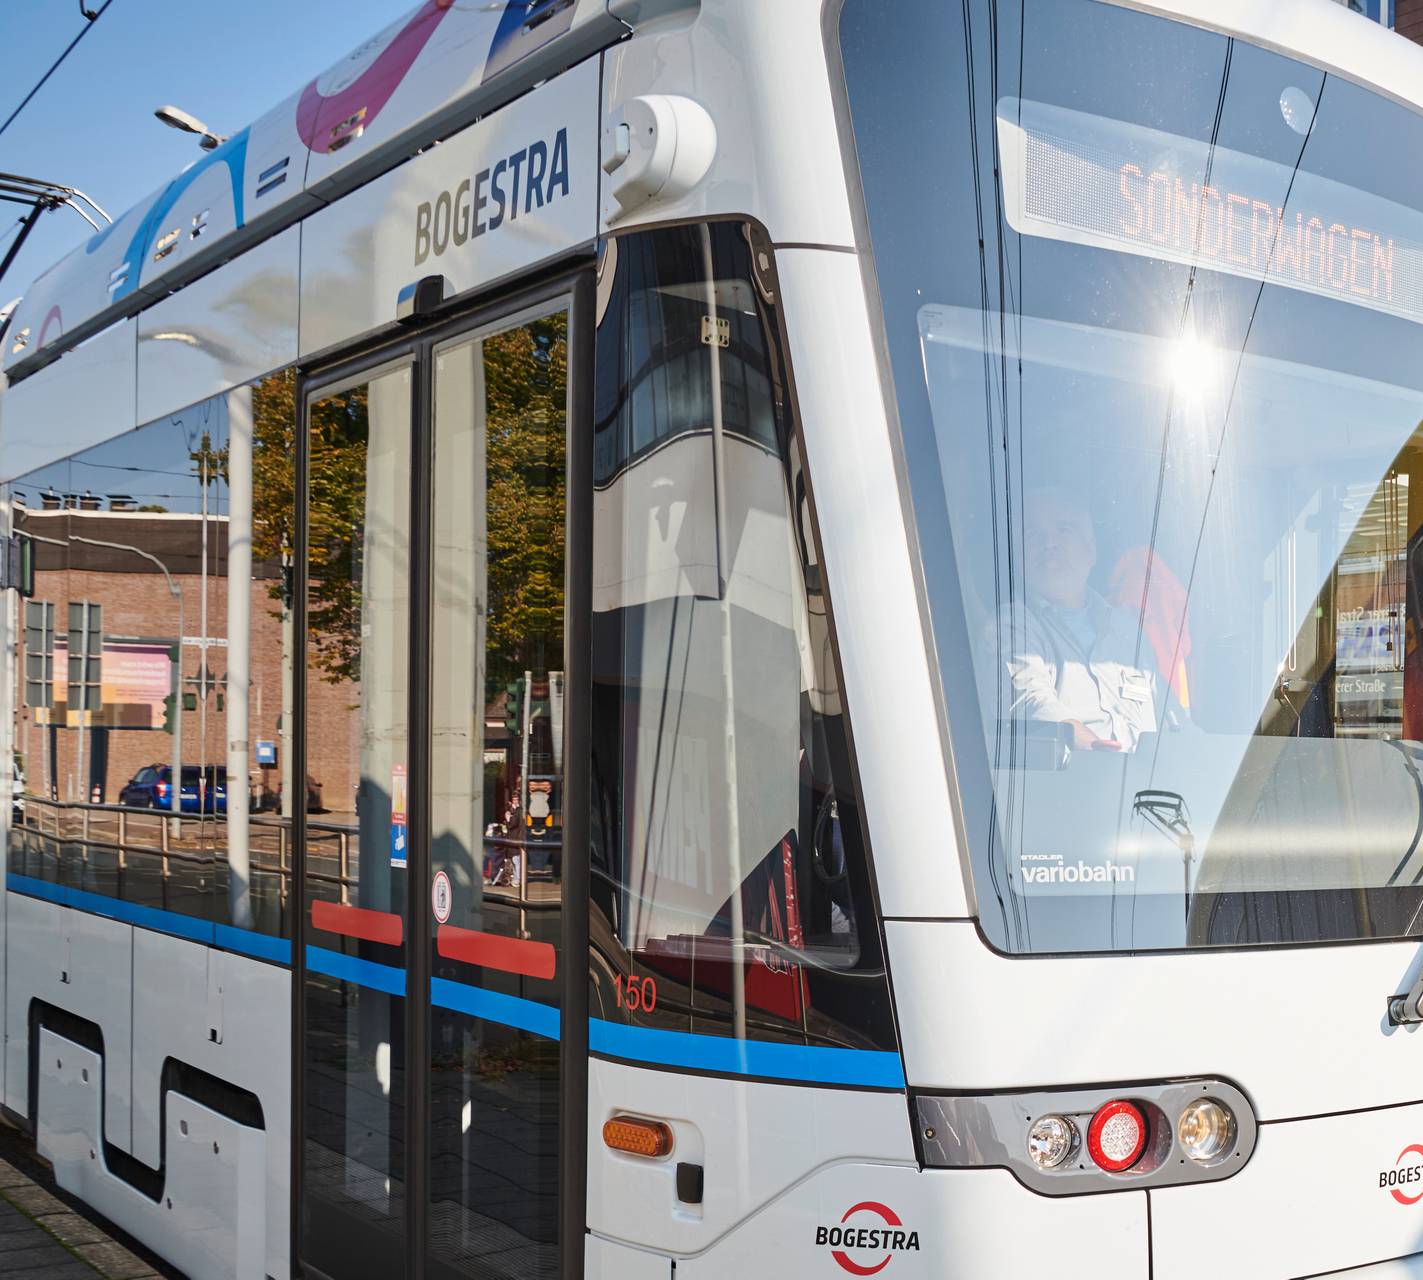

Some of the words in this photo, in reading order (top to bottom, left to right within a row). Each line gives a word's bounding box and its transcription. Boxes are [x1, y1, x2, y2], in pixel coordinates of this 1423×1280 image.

[413, 127, 570, 268] BOGESTRA
[1119, 163, 1393, 301] SONDERWAGEN
[1355, 678, 1387, 694] Straße
[1021, 860, 1135, 883] variobahn
[614, 974, 657, 1013] 150
[815, 1226, 921, 1251] BOGESTRA
